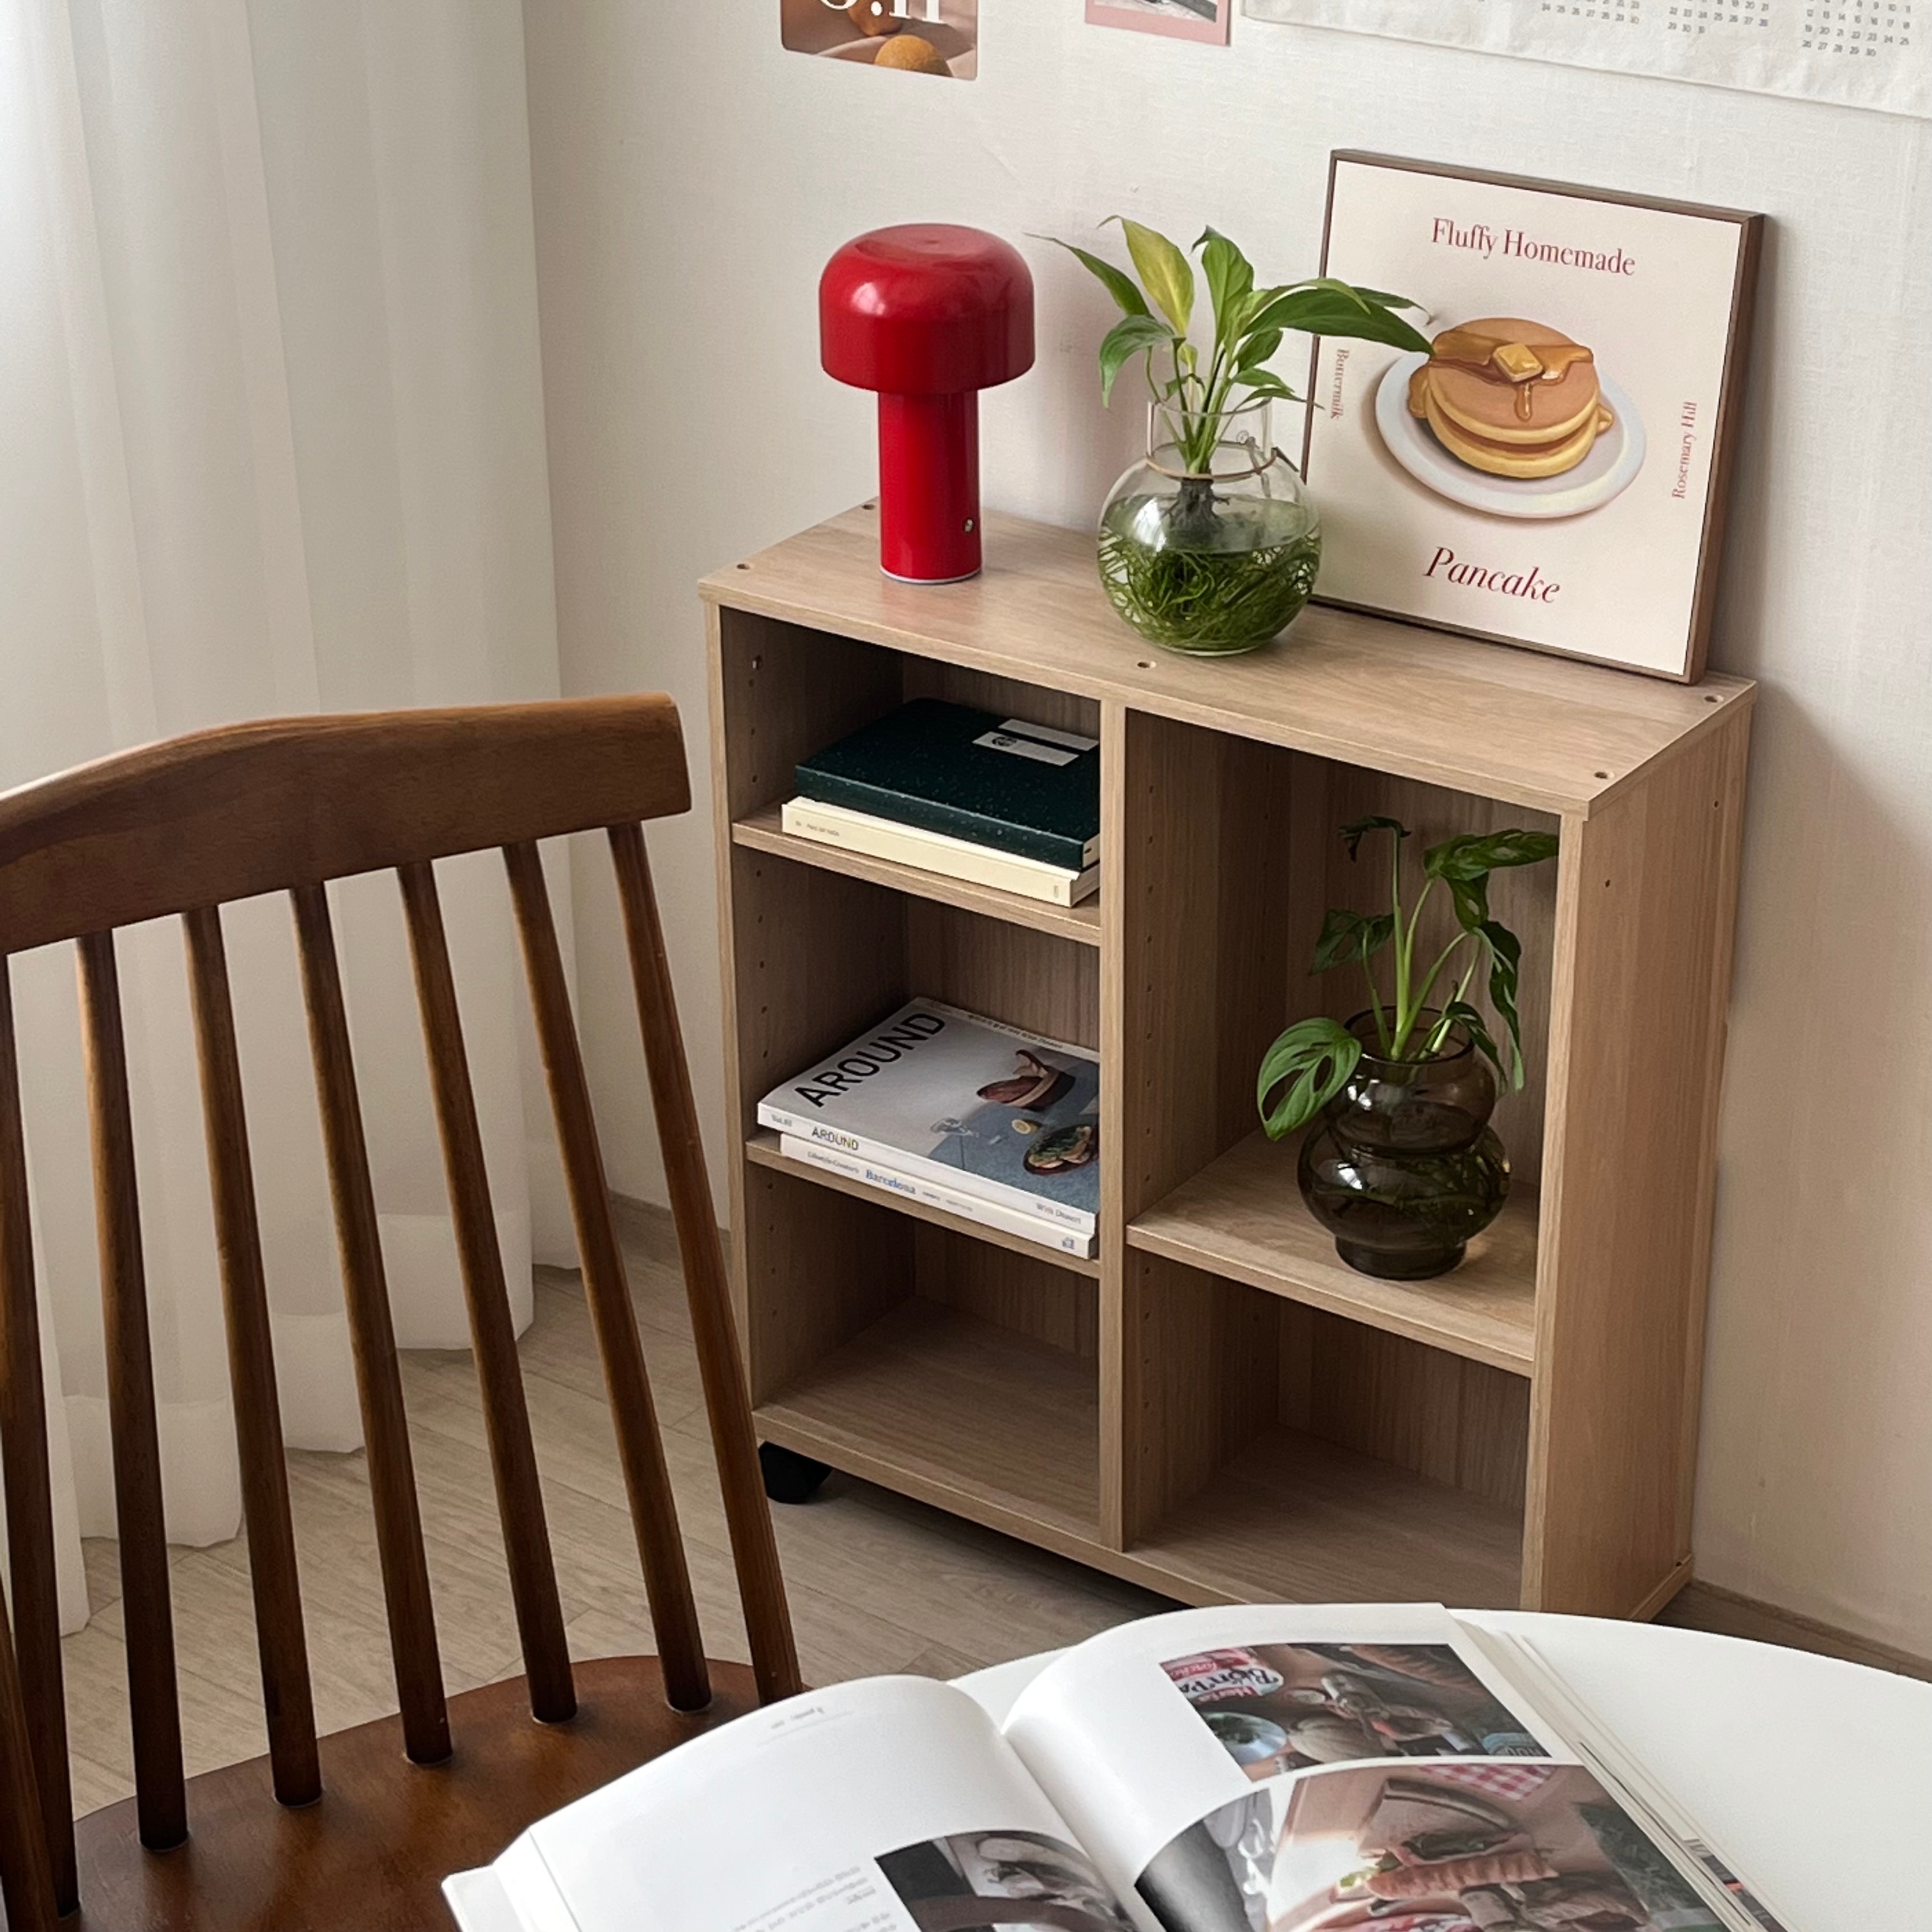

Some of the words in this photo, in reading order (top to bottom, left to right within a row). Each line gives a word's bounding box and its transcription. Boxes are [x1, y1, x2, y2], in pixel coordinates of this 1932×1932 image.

[1432, 217, 1498, 259] Fluffy
[1503, 228, 1636, 275] Homemade
[1331, 349, 1349, 419] Buttermilk
[1681, 401, 1698, 427] Hill
[1671, 433, 1697, 499] Rosemary
[1423, 546, 1560, 603] Pancake
[794, 1013, 946, 1108] AROUND
[812, 1126, 859, 1151] AROUND
[866, 1169, 916, 1194] Barcelona
